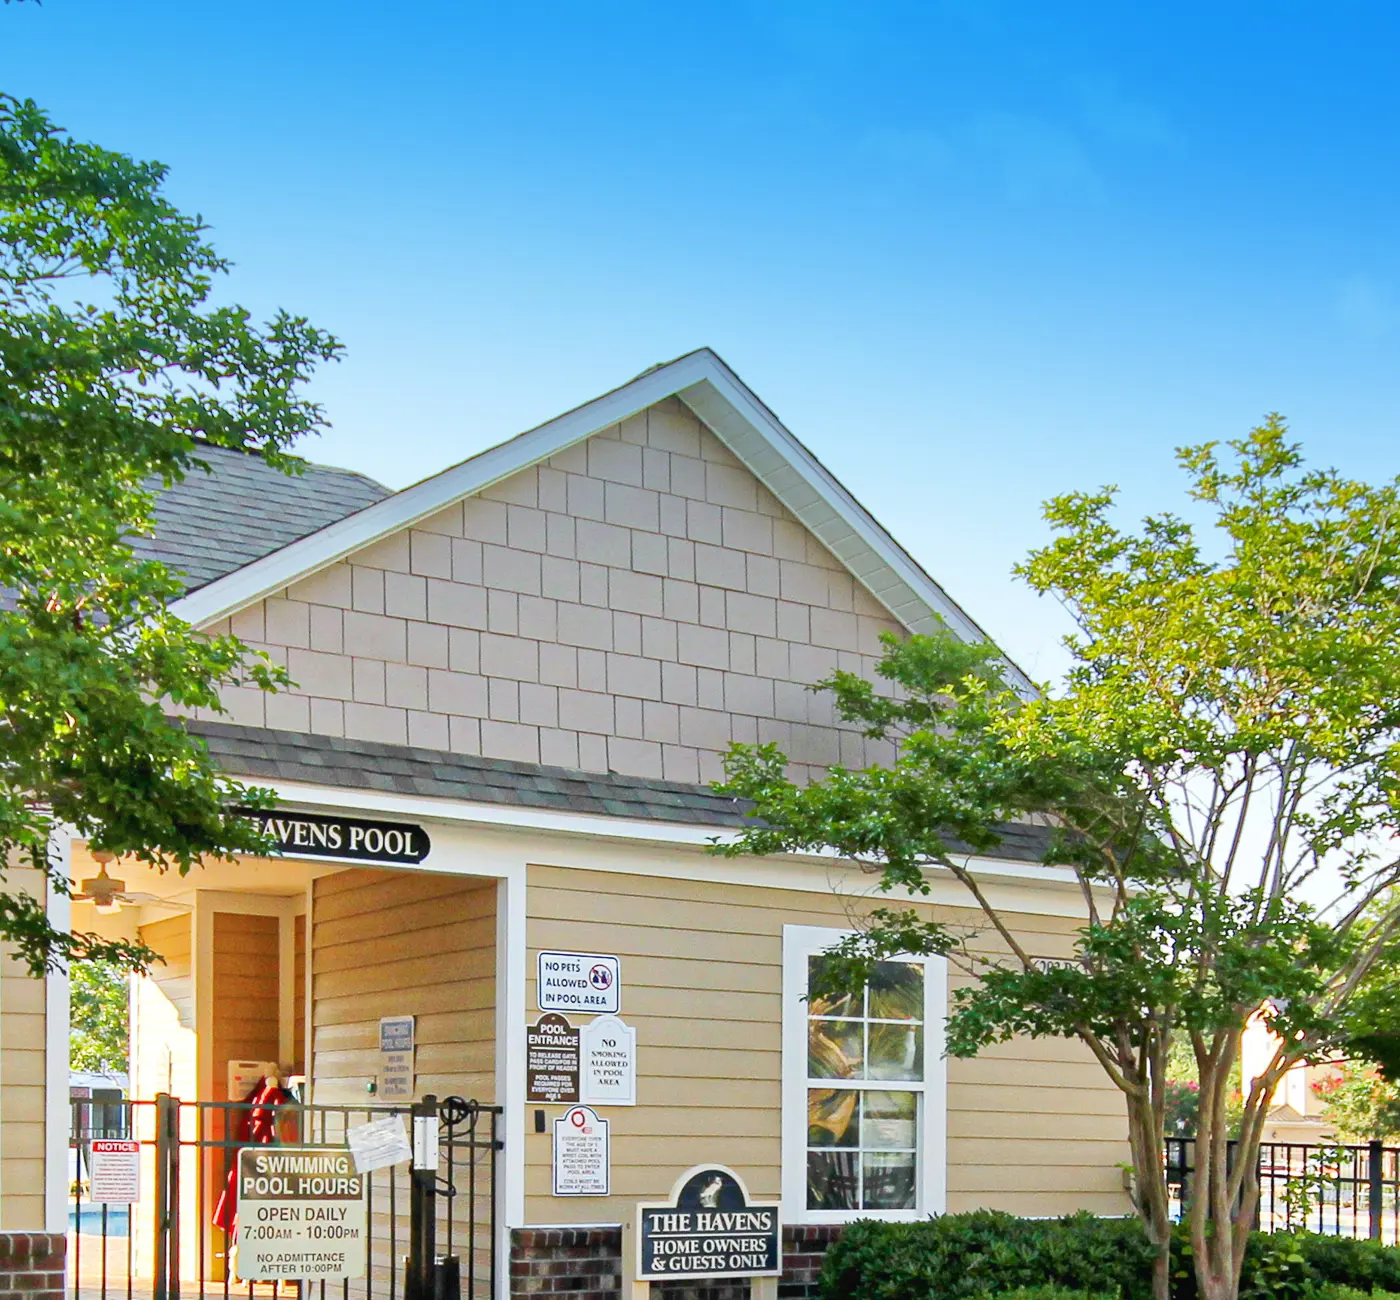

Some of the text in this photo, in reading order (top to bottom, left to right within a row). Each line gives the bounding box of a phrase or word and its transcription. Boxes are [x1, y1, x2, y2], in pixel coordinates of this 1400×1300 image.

[349, 826, 419, 857] POOL
[545, 962, 580, 972] NO PETS
[546, 978, 588, 988] ALLOWED
[545, 994, 607, 1005] IN POOL AREA
[540, 1024, 567, 1035] POOL
[528, 1035, 579, 1046] ENTRANCE
[602, 1039, 616, 1048] NO
[591, 1051, 627, 1059] SMOKING
[591, 1060, 628, 1068] ALLOWED
[97, 1143, 136, 1151] NOTICE
[256, 1156, 348, 1174] SWIMMING
[243, 1178, 360, 1195] POOL HOURS
[257, 1207, 347, 1222] OPEN DAILY
[648, 1212, 771, 1232] THE HAVENS
[244, 1226, 292, 1240] 7:00AM
[307, 1225, 359, 1239] 10:00PM
[653, 1238, 767, 1255] HOME OWNERS
[257, 1253, 345, 1262] NO ADMITTANCE
[651, 1254, 768, 1271] & GUESTS ONLY
[260, 1264, 341, 1273] AFTER 10:00PM
